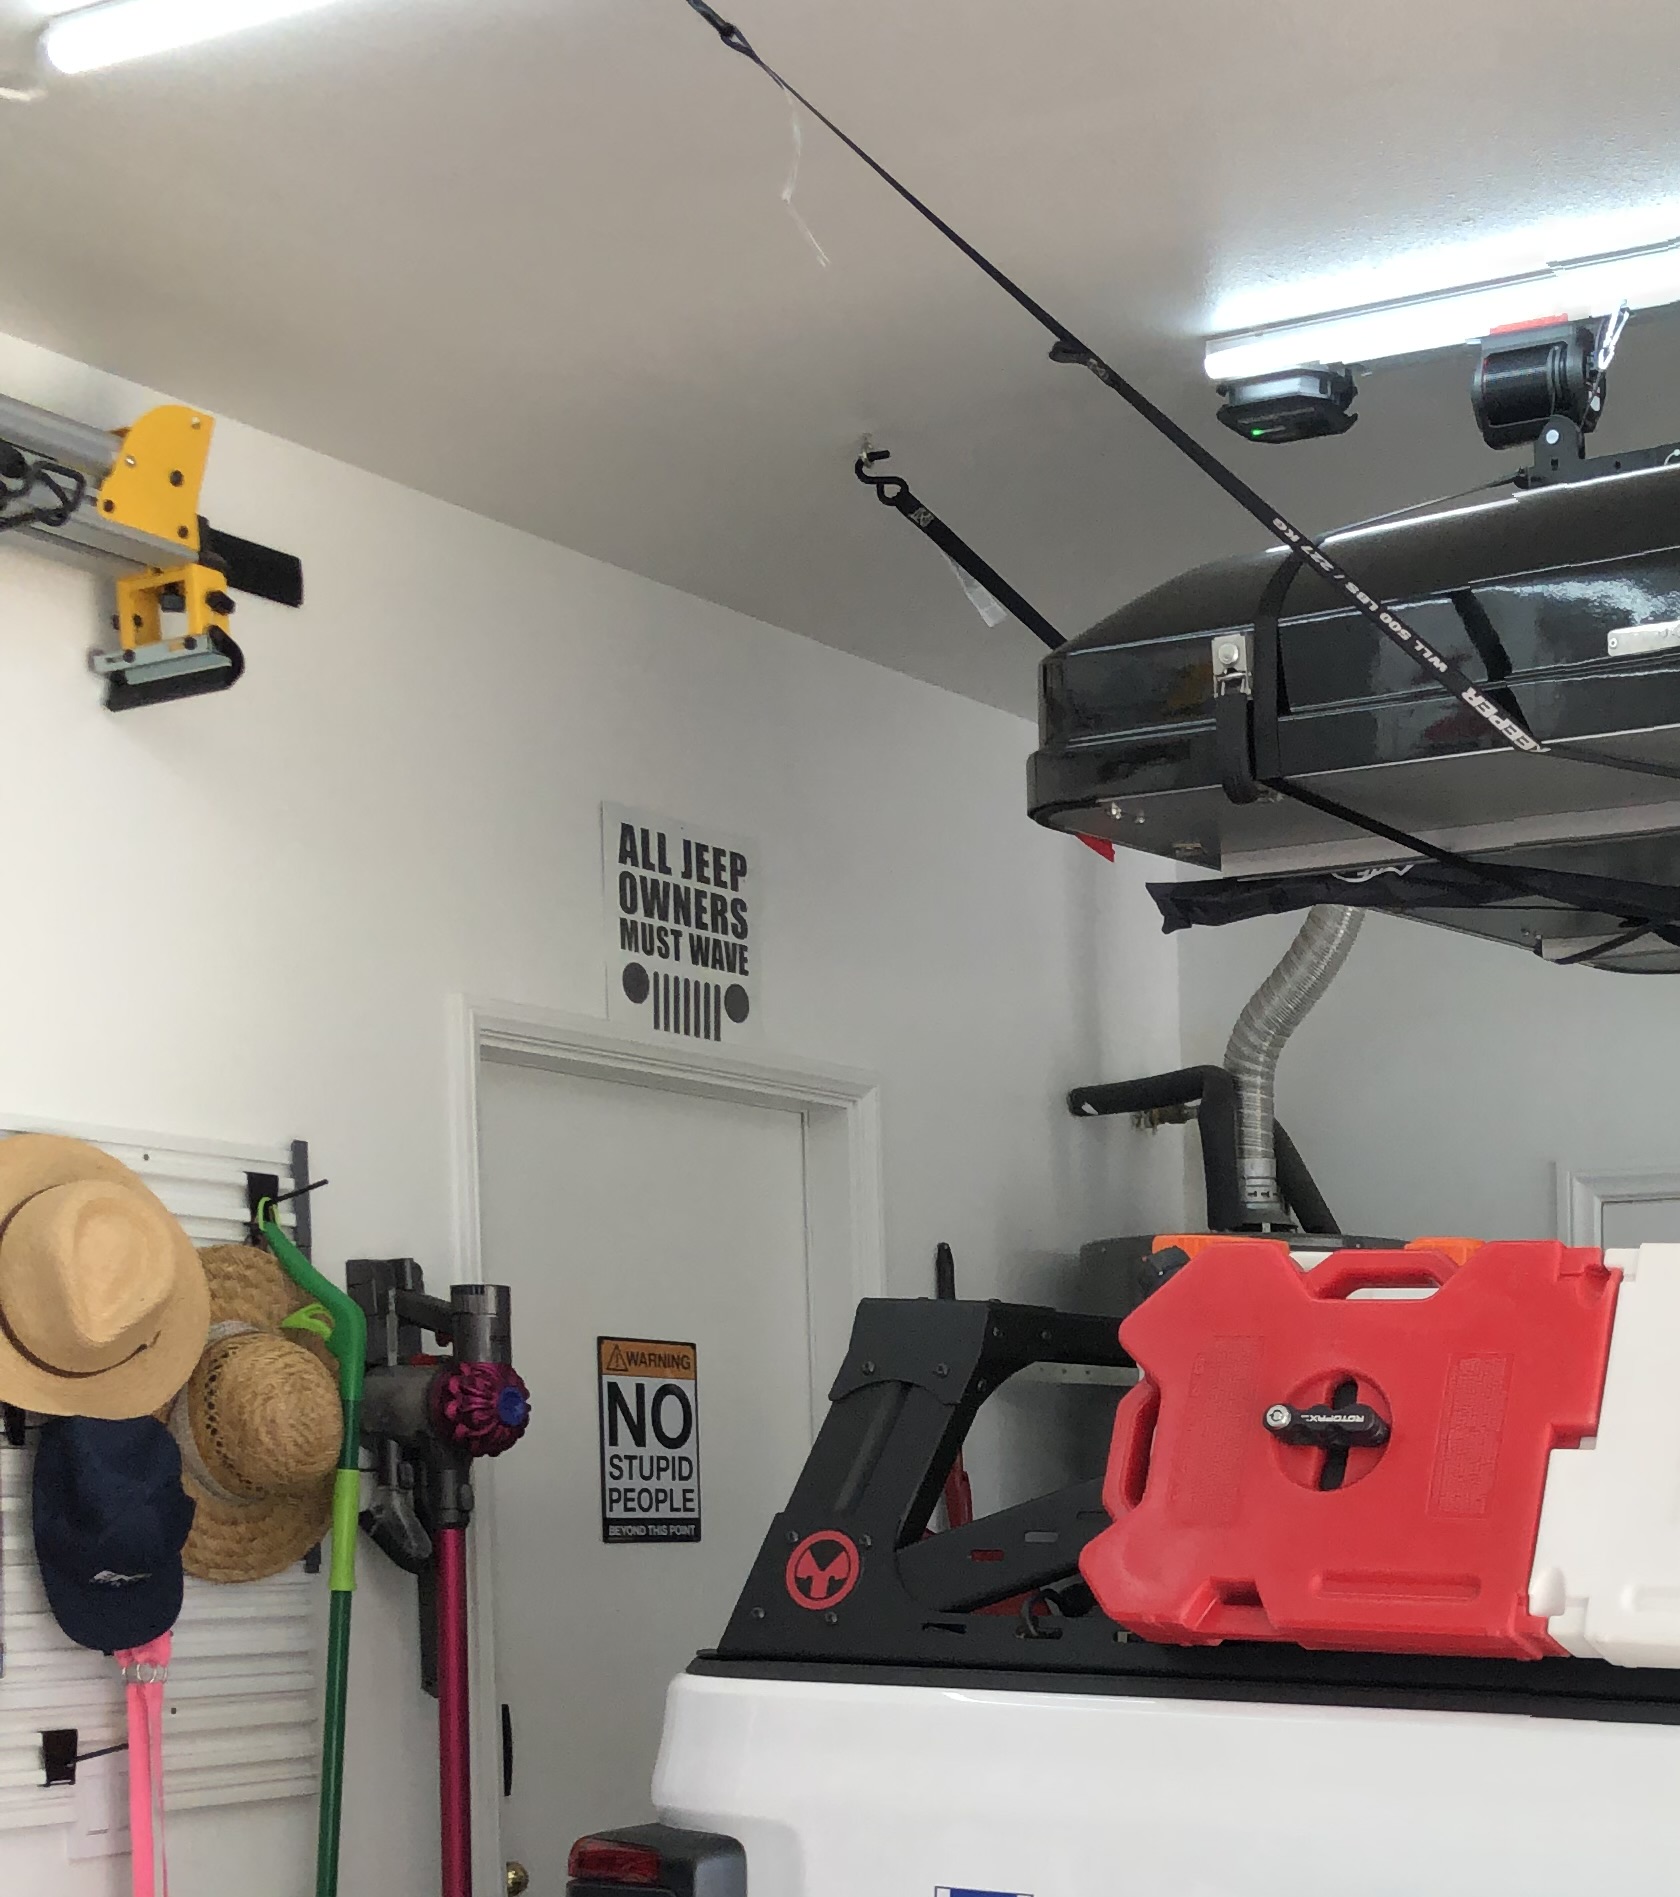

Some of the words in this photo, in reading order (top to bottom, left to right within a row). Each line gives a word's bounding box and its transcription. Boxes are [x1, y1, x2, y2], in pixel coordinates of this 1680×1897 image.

[1273, 517, 1300, 542] KG
[1301, 545, 1333, 572] 227
[1345, 582, 1378, 611] LBS
[1380, 612, 1411, 640] 500
[1415, 640, 1448, 673] WLL
[618, 822, 672, 876] ALL
[681, 838, 748, 892] JEEP
[618, 870, 749, 940] OWNERS
[619, 917, 683, 962] MUST
[688, 932, 749, 977] WAVE
[626, 1351, 691, 1370] WARNING
[607, 1380, 693, 1450] NO
[608, 1453, 694, 1482] STUPID
[608, 1487, 696, 1513] PEOPLE
[608, 1524, 647, 1537] BEYOND
[648, 1524, 668, 1536] THIS
[670, 1524, 696, 1537] POINT
